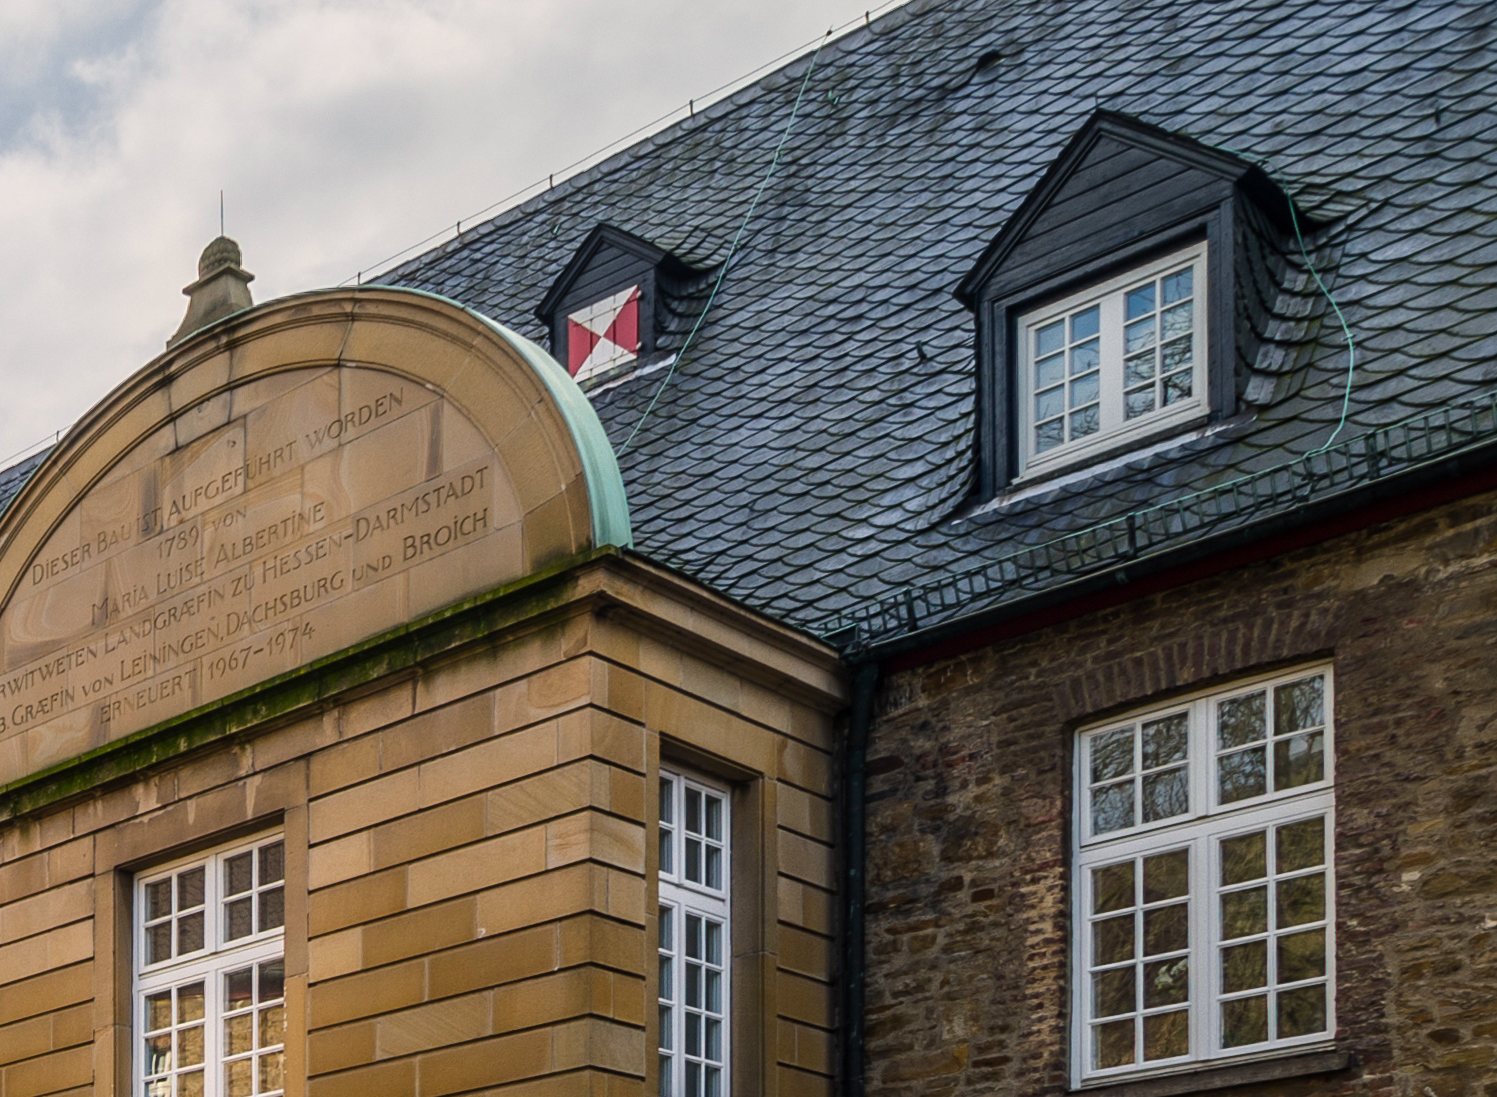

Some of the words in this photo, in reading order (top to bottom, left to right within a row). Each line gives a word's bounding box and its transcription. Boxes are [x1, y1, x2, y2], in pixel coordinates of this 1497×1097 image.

[97, 521, 132, 554] BAU
[167, 440, 297, 522] AUFGEFÜHRT
[305, 387, 404, 451] WORDEN
[156, 525, 199, 561] 1789
[211, 505, 248, 532] VON
[231, 570, 255, 598] ZU
[262, 466, 489, 584] HESSEN-DARMSTADT
[81, 672, 114, 698] VON
[226, 570, 344, 636] DACHSBURG
[352, 554, 392, 582] UND
[100, 667, 197, 725] ERNEUERT
[207, 621, 316, 680] 1967-1974
